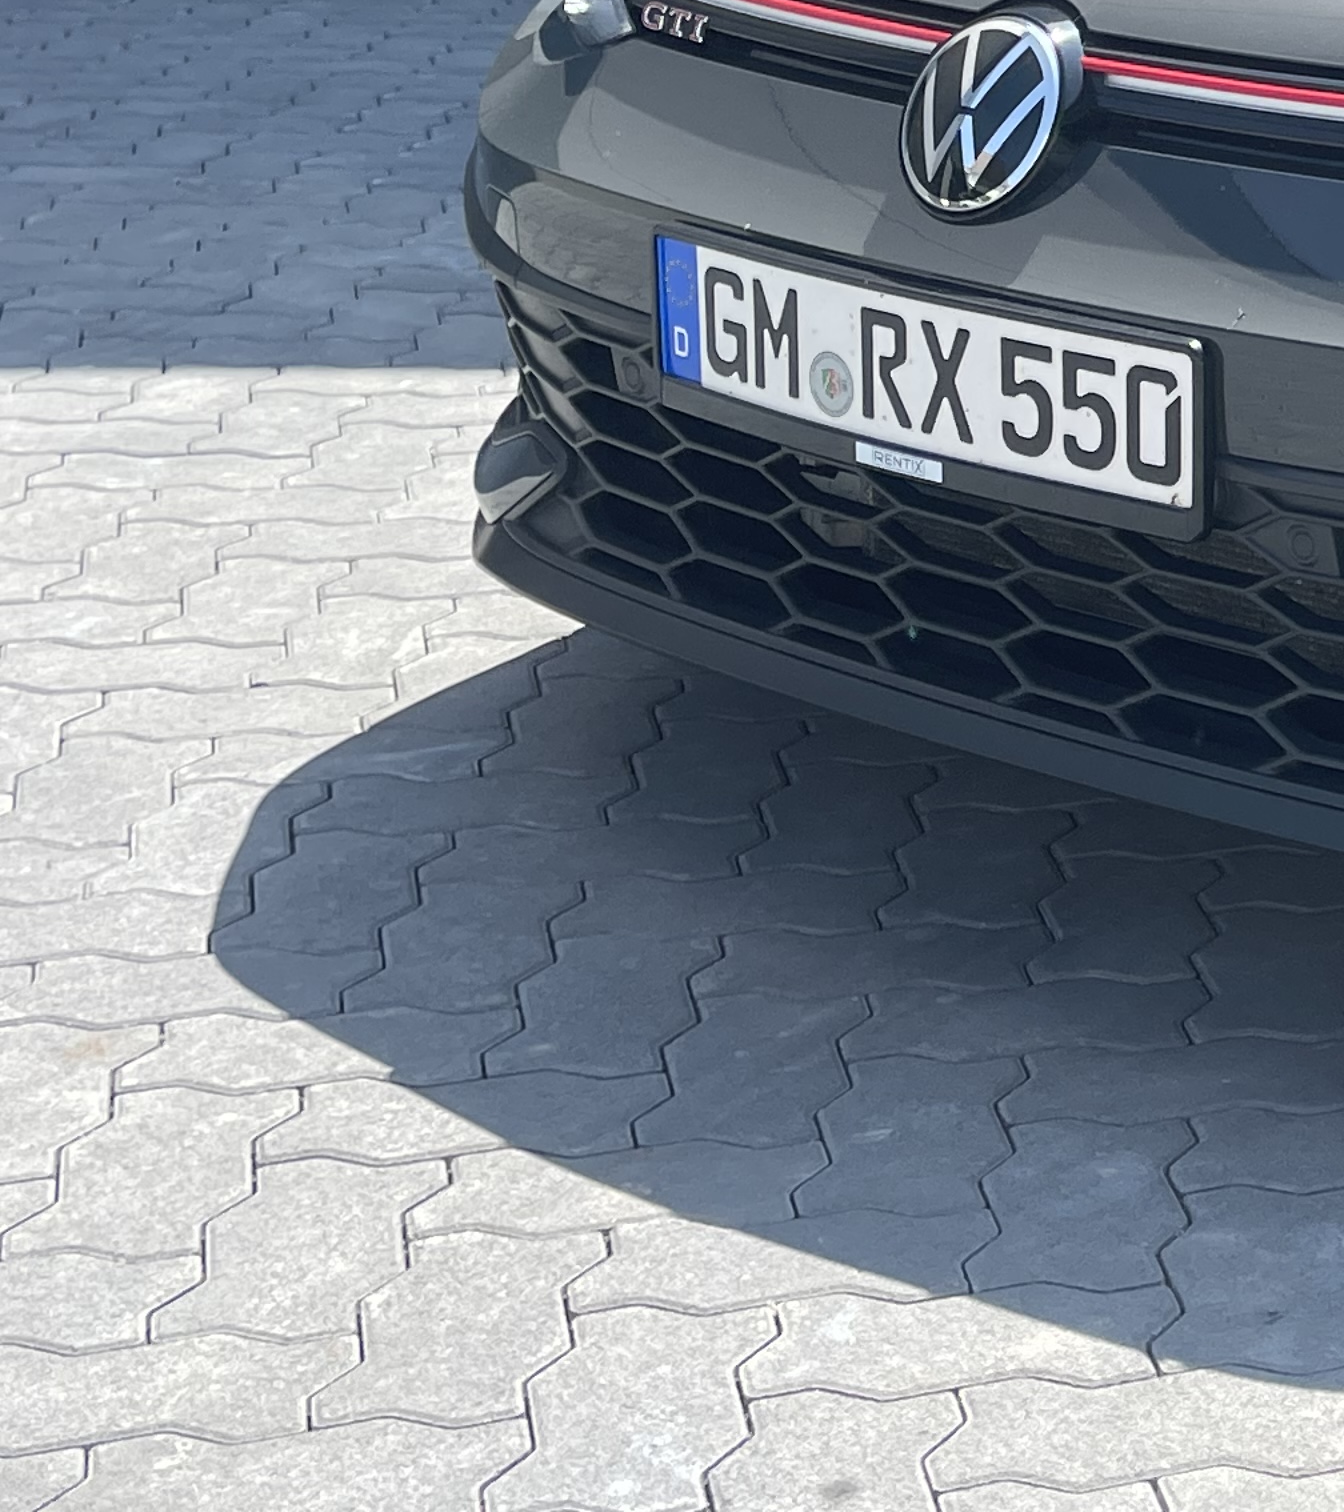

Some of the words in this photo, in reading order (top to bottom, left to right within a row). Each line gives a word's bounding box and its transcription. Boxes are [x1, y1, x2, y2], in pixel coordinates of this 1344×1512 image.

[641, 1, 708, 43] GTI
[674, 325, 688, 358] D
[704, 266, 799, 399] GM
[860, 306, 973, 444] RX
[1001, 337, 1181, 486] 550
[874, 450, 925, 474] RENTIX
